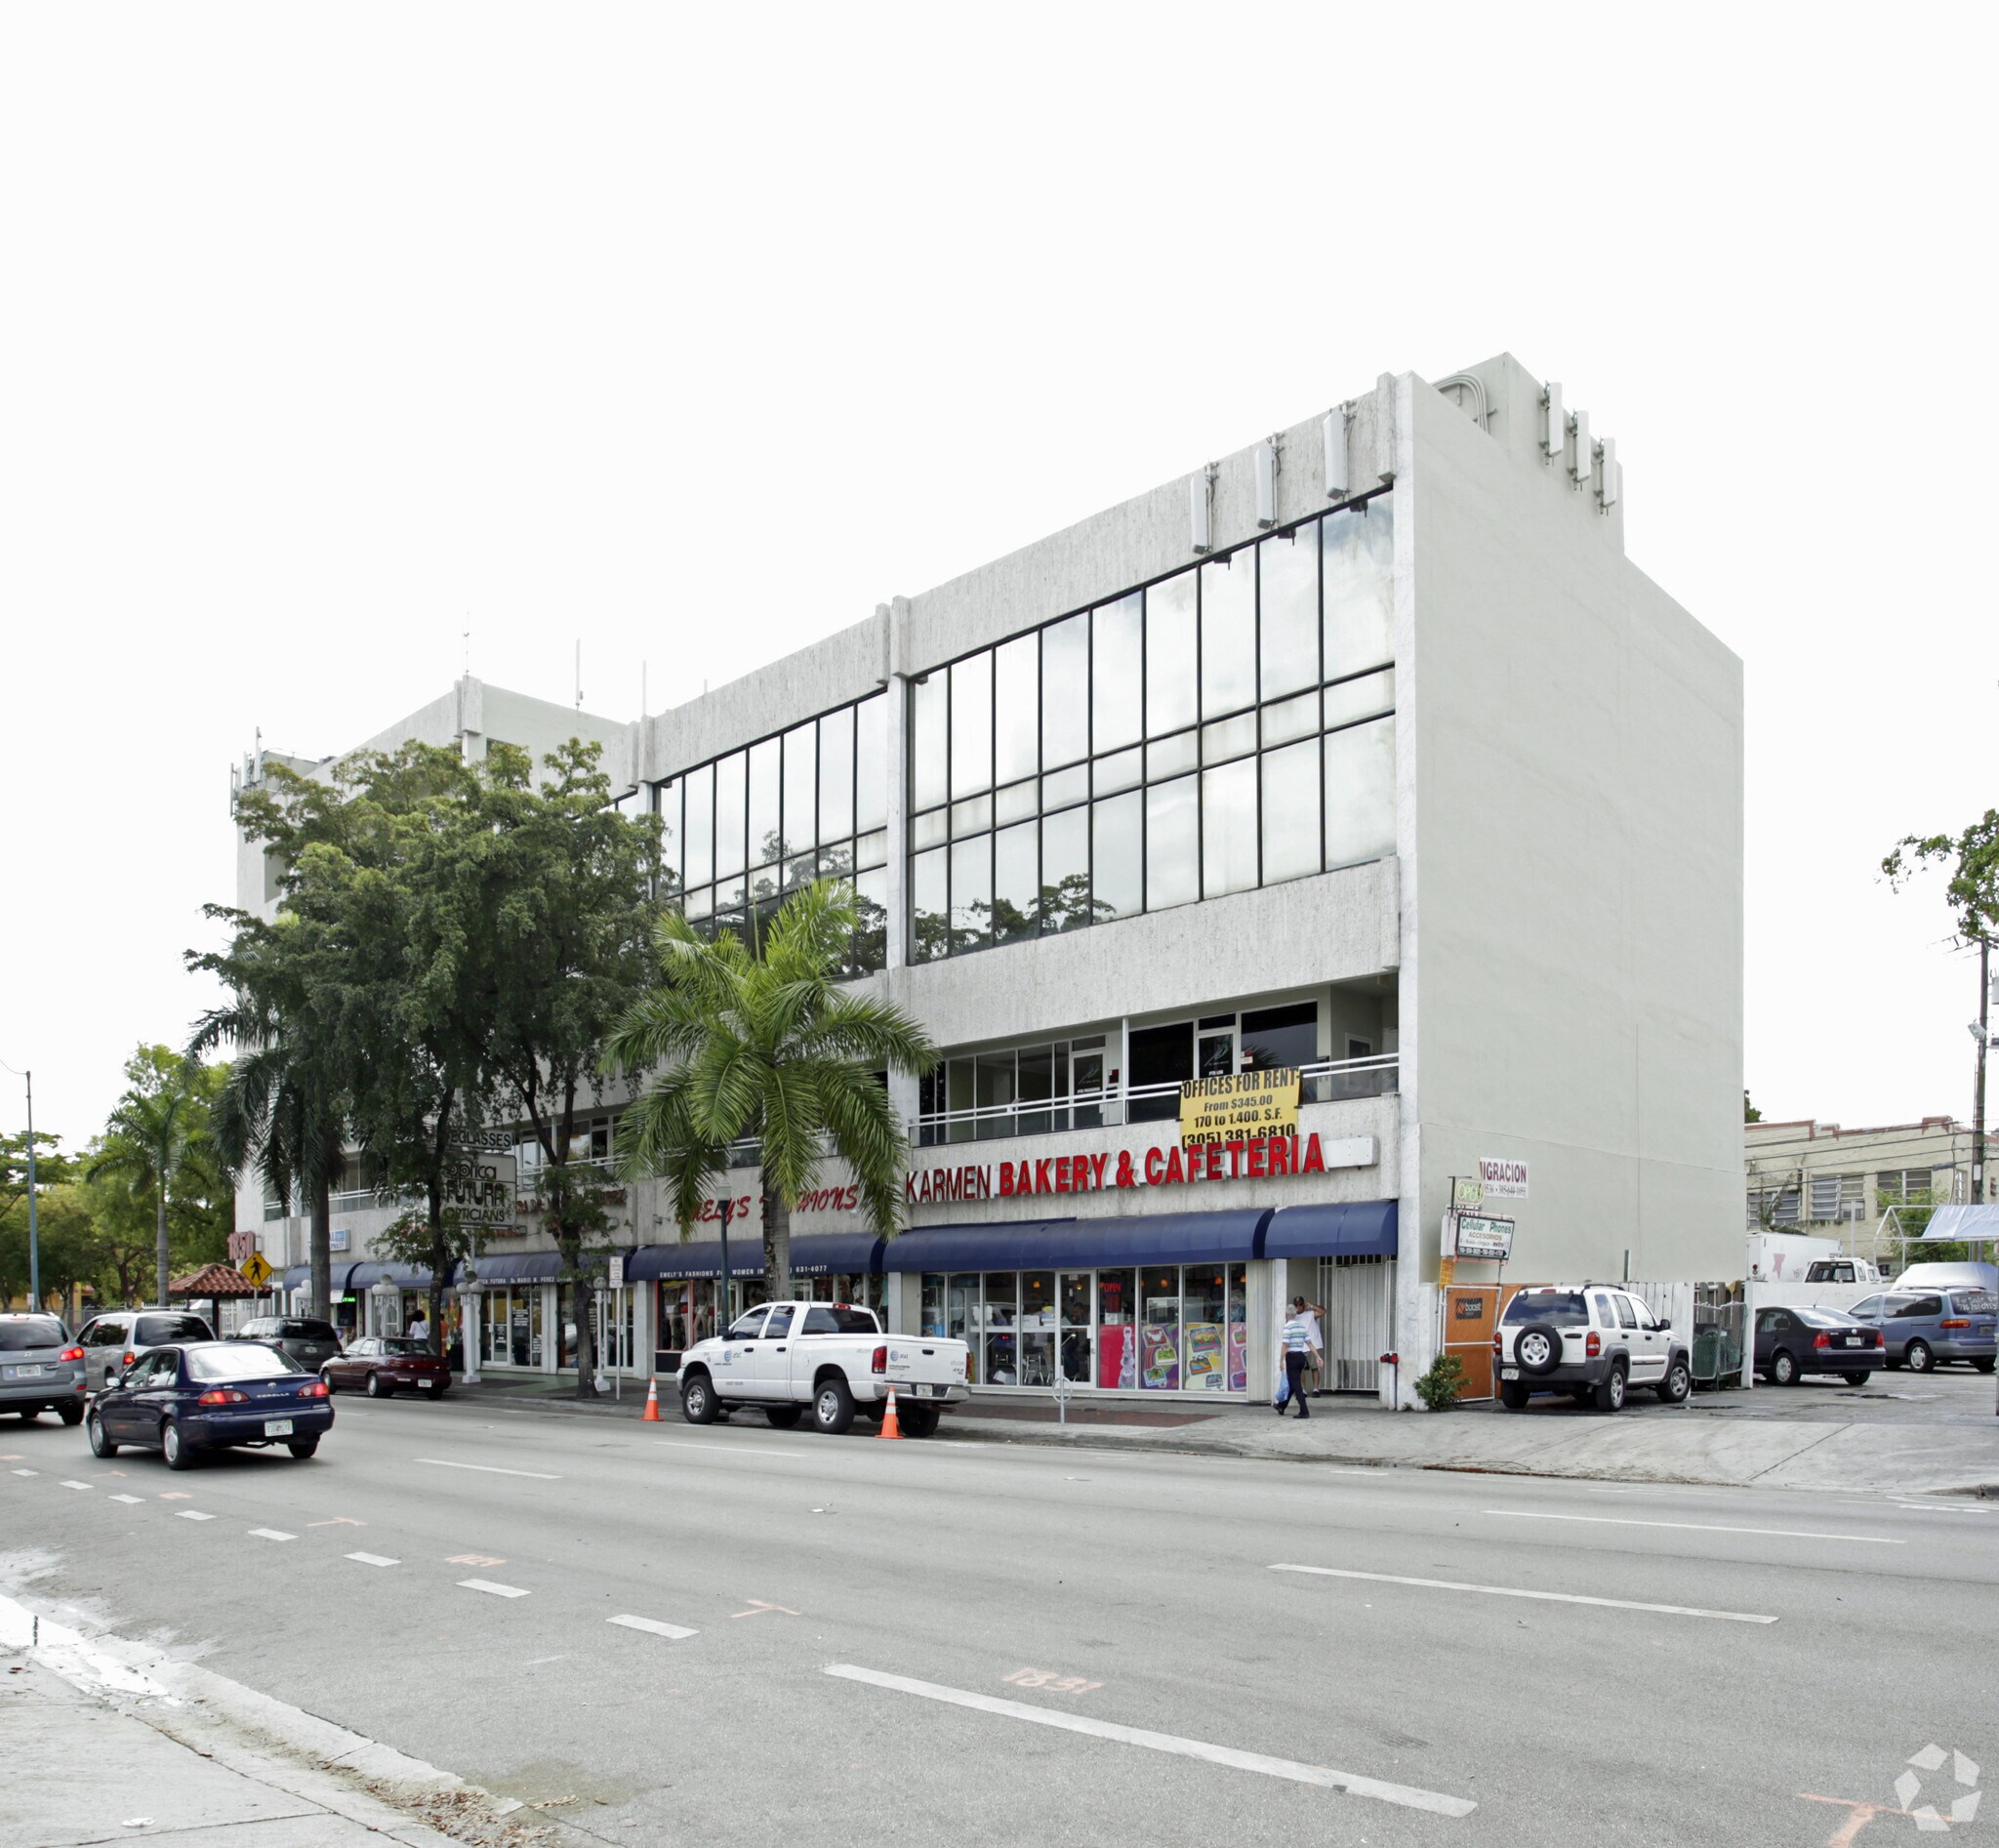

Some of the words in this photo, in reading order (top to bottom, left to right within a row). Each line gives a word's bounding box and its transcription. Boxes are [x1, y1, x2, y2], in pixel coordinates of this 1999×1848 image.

[1183, 1075, 1234, 1099] OFFICES
[1236, 1072, 1260, 1092] FOR
[1263, 1067, 1296, 1089] RENT
[1203, 1100, 1229, 1112] From
[1231, 1094, 1273, 1109] $345.00
[1195, 1115, 1211, 1129] 170
[1214, 1114, 1226, 1127] to
[1264, 1107, 1283, 1121] S.F.
[1225, 1123, 1296, 1142] 381-6810
[906, 1164, 992, 1204] KARMEN
[1000, 1152, 1109, 1197] BAKERY
[1116, 1149, 1136, 1188] &
[1145, 1132, 1326, 1186] CAFETERIA
[1456, 1182, 1482, 1202] OPEN
[1461, 1218, 1485, 1231] Cellular
[1489, 1221, 1512, 1234] Phones
[1468, 1232, 1503, 1242] ACCESORIOS
[796, 1264, 828, 1273] 631-4077
